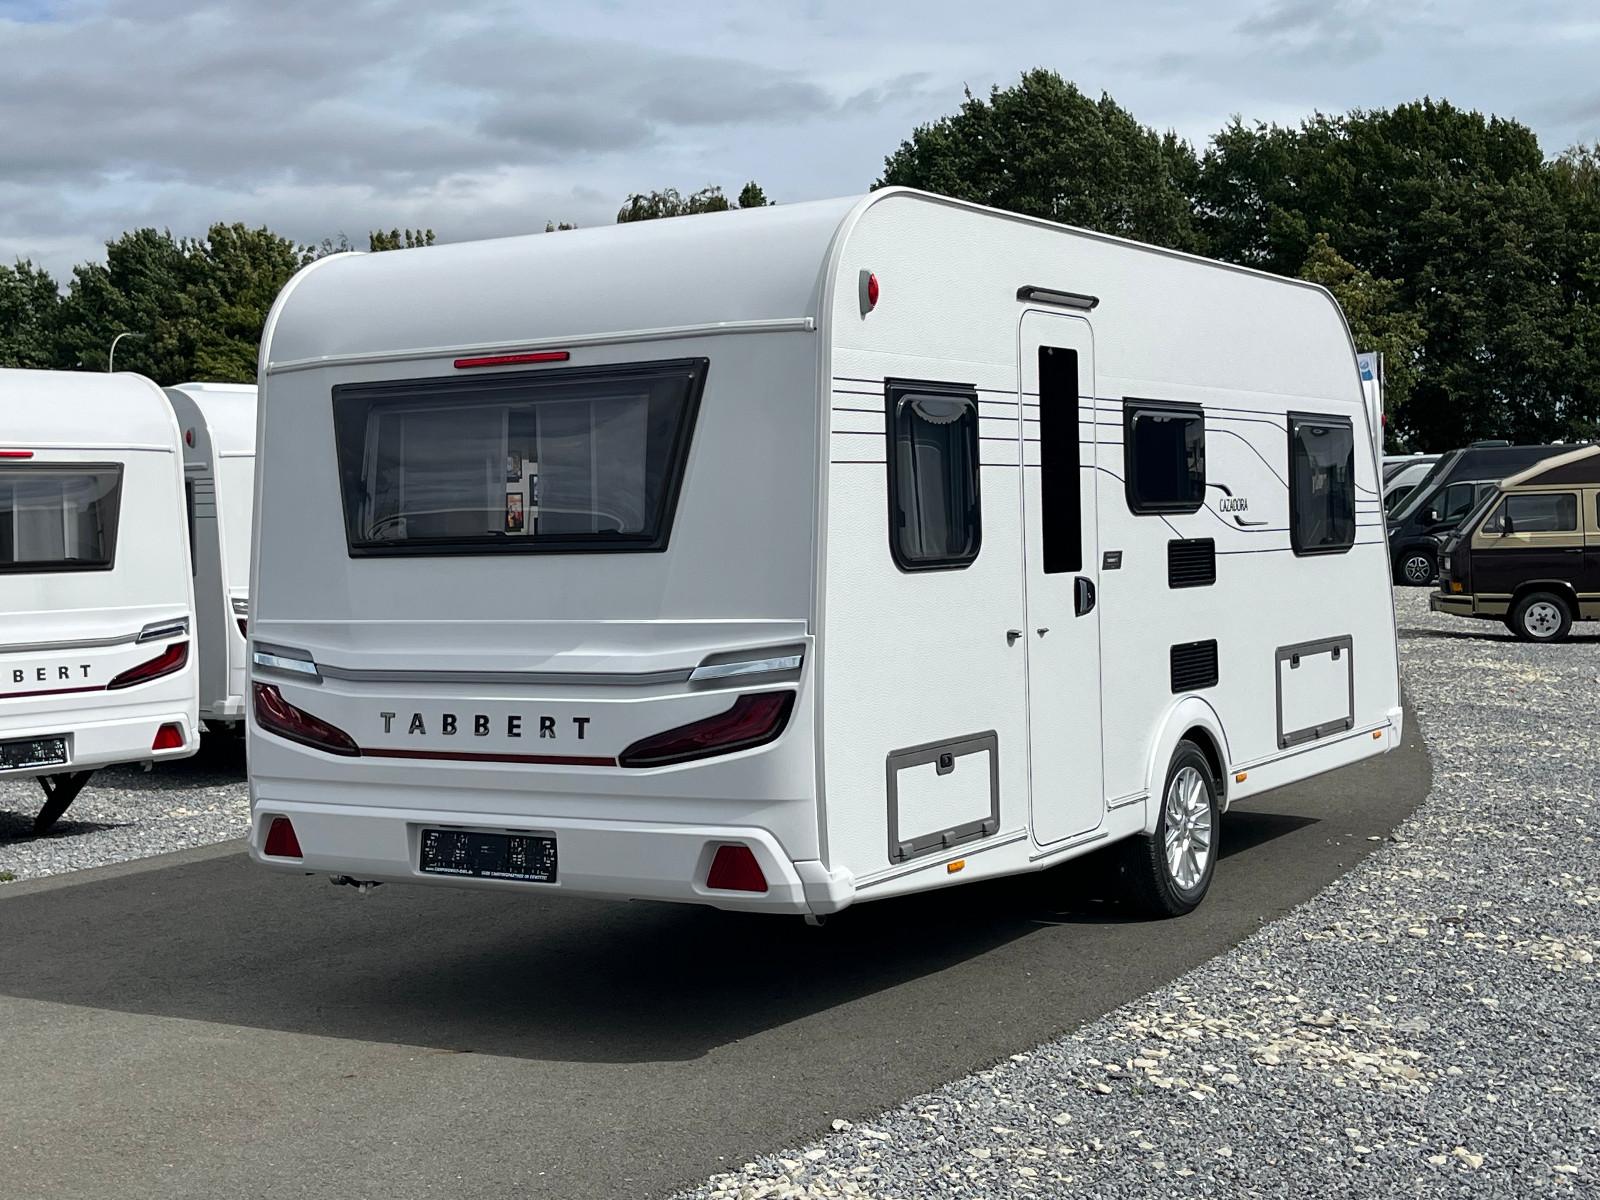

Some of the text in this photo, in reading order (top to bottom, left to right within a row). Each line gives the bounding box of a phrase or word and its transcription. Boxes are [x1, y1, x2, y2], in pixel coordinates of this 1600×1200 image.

[1219, 497, 1248, 512] CAZADORA
[13, 664, 91, 683] BERT
[380, 711, 591, 740] TABBERT
